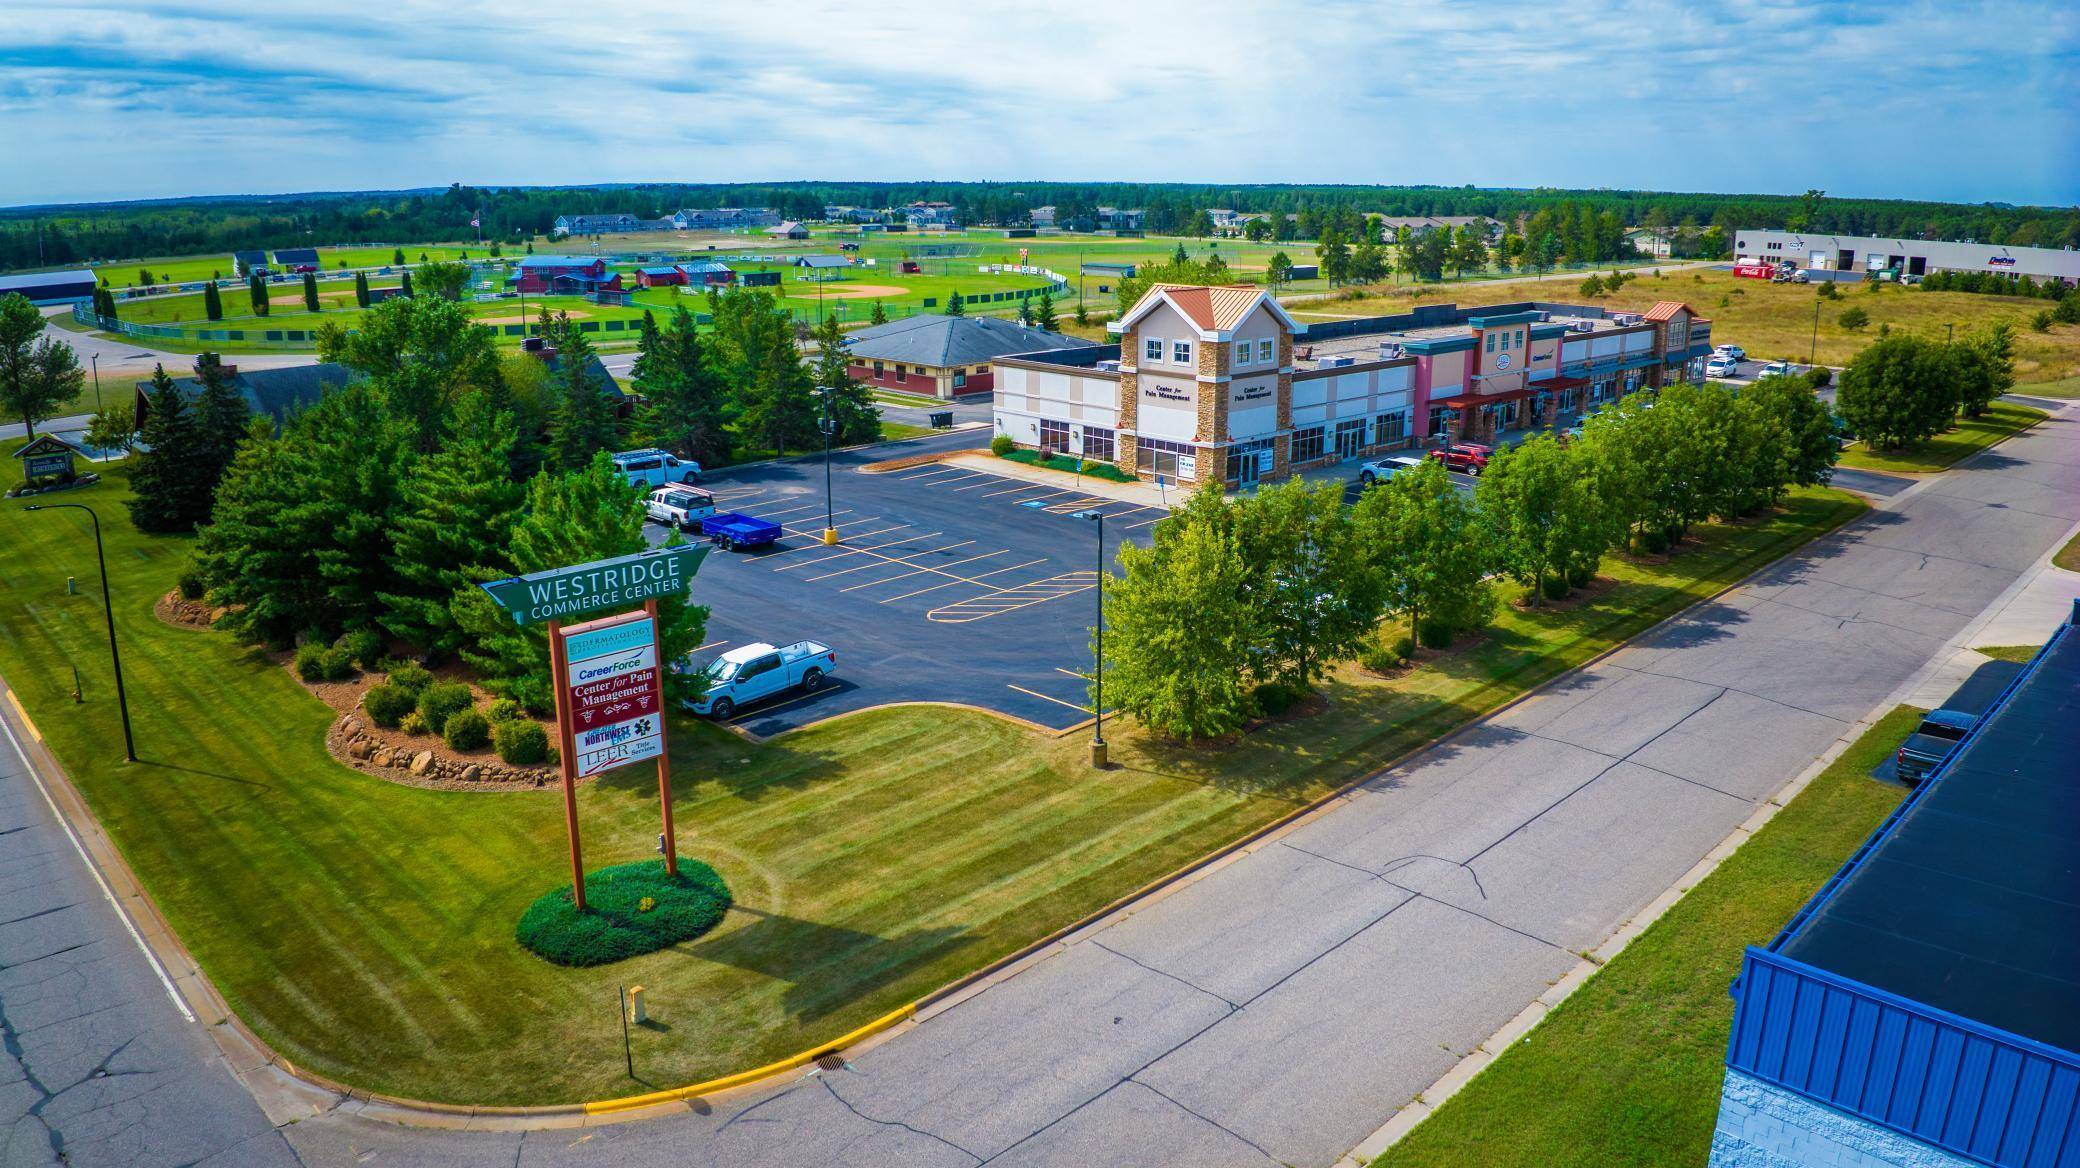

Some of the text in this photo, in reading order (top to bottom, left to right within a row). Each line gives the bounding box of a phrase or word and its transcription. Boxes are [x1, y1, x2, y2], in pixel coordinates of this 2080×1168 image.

[1145, 390, 1190, 401] Pain Management
[1156, 385, 1173, 393] Center
[1246, 391, 1271, 400] Management
[529, 557, 681, 604] WESTRIDGE
[531, 579, 680, 619] COMMERCE CENTER
[582, 626, 650, 647] DERMATOLOGY
[579, 660, 640, 680] CareerForce
[575, 670, 653, 698] Center for Pain
[582, 683, 649, 707] Management
[585, 726, 631, 746] NORTHWEST
[636, 741, 650, 749] Title
[587, 745, 629, 765] LEER
[631, 746, 656, 755] Services
